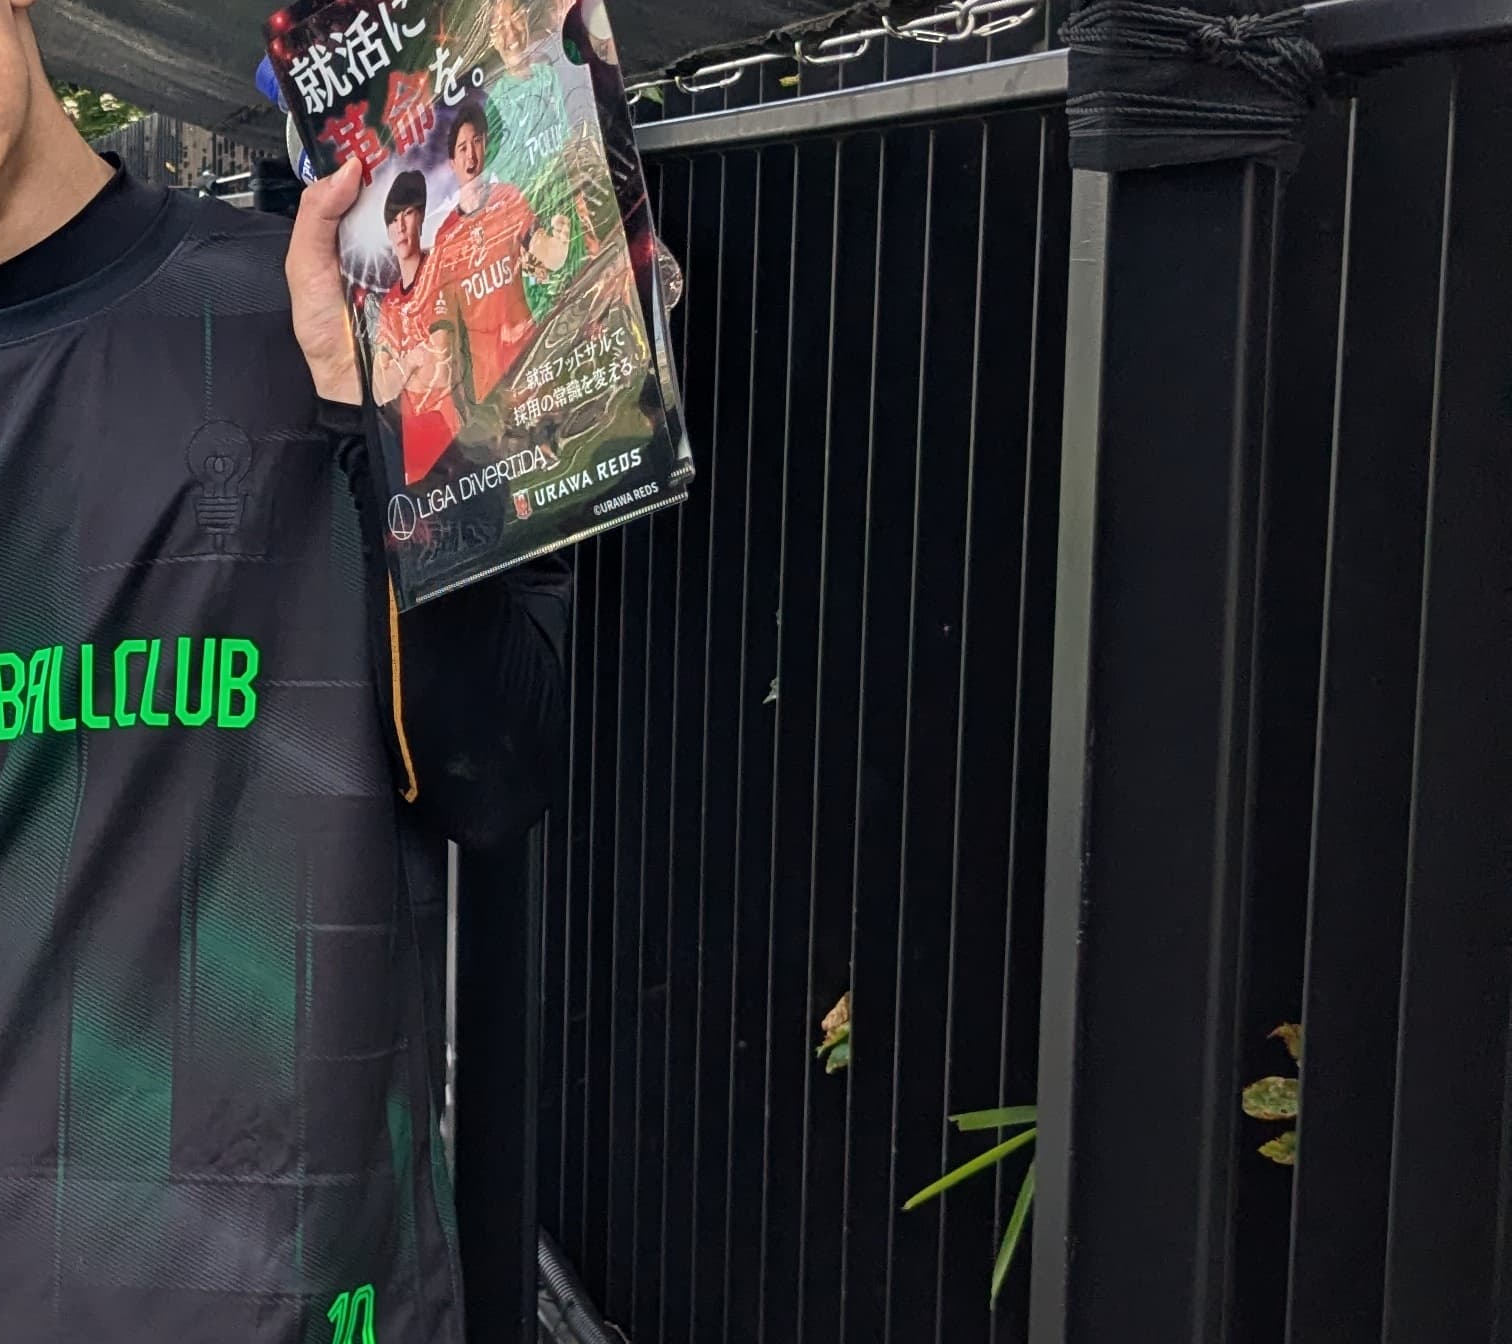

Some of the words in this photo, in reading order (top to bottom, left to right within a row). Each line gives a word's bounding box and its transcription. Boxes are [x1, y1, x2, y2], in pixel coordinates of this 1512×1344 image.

[461, 256, 514, 306] POLUS
[513, 356, 633, 427] 採用の常識を変える
[534, 469, 594, 506] URAWA
[596, 447, 642, 481] REDS
[634, 481, 660, 501] REDS
